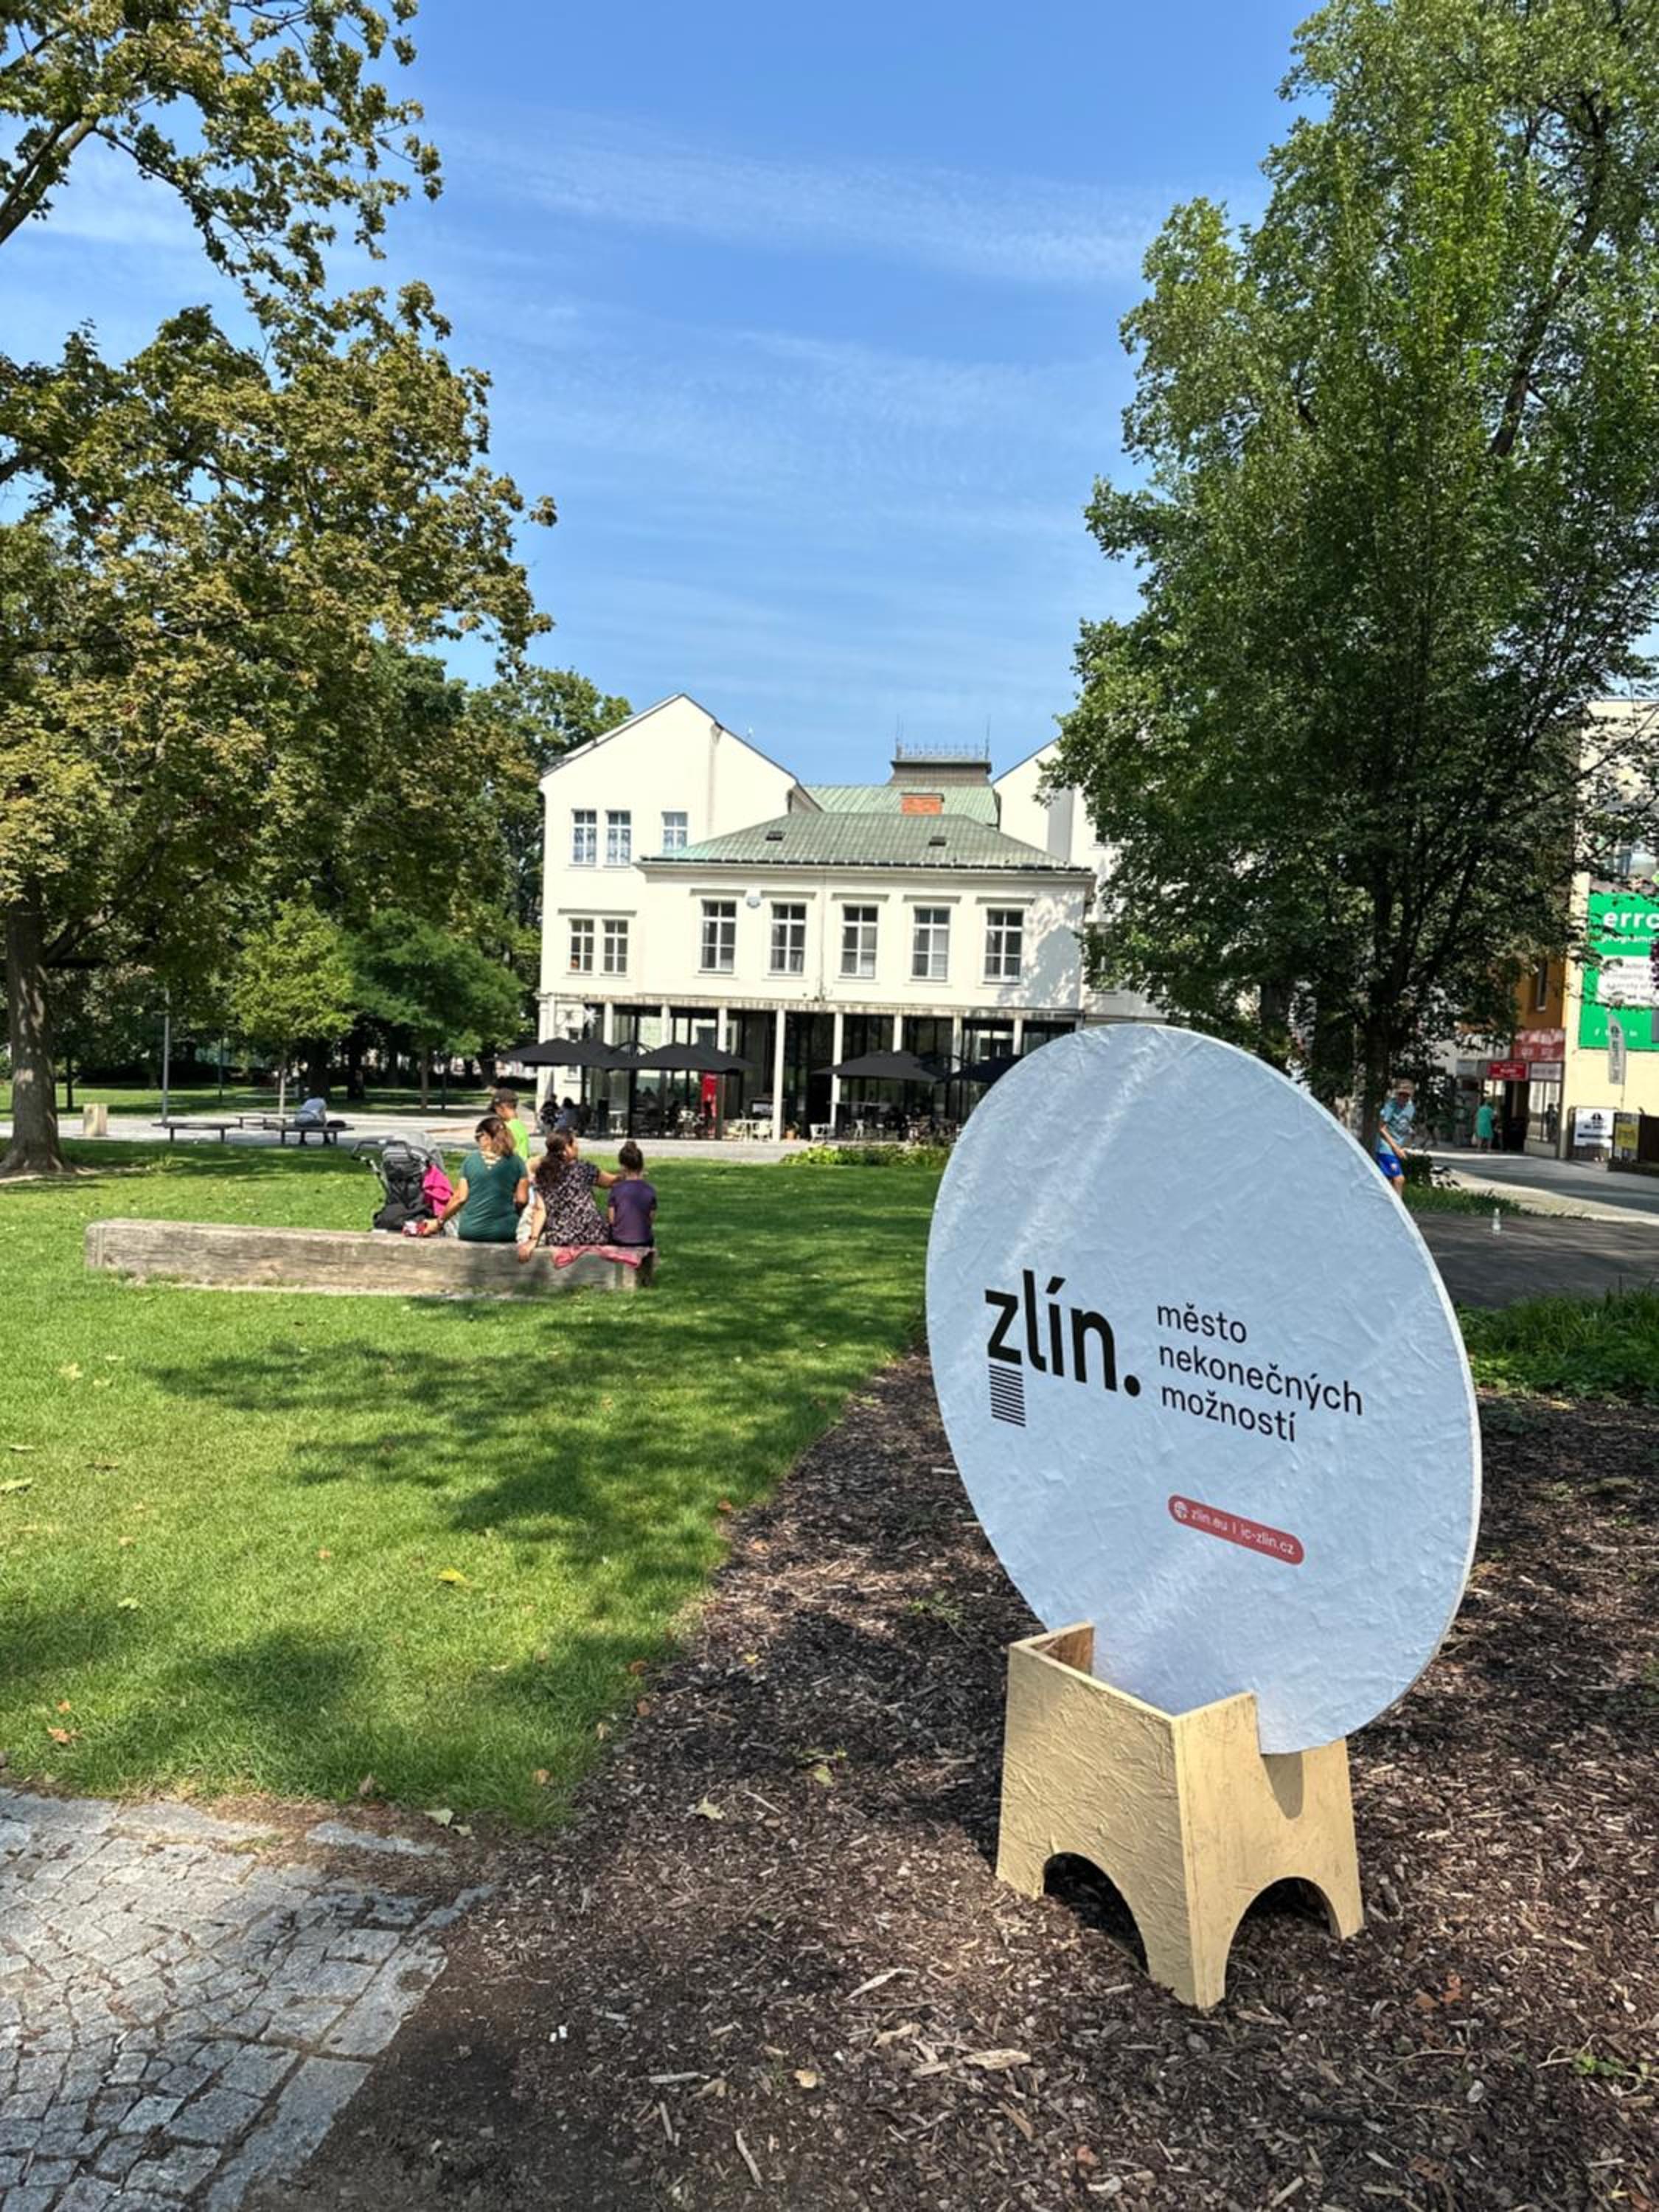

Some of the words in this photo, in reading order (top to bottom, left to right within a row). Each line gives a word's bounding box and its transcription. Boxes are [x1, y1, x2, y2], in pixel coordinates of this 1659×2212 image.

[985, 1269, 1141, 1397] zlín.
[1157, 1303, 1247, 1343] město
[1159, 1346, 1362, 1416] nekonečných
[1161, 1387, 1295, 1442] možností
[1191, 1509, 1228, 1531] zlin.eu
[1241, 1523, 1295, 1555] ic-zlin.cz
